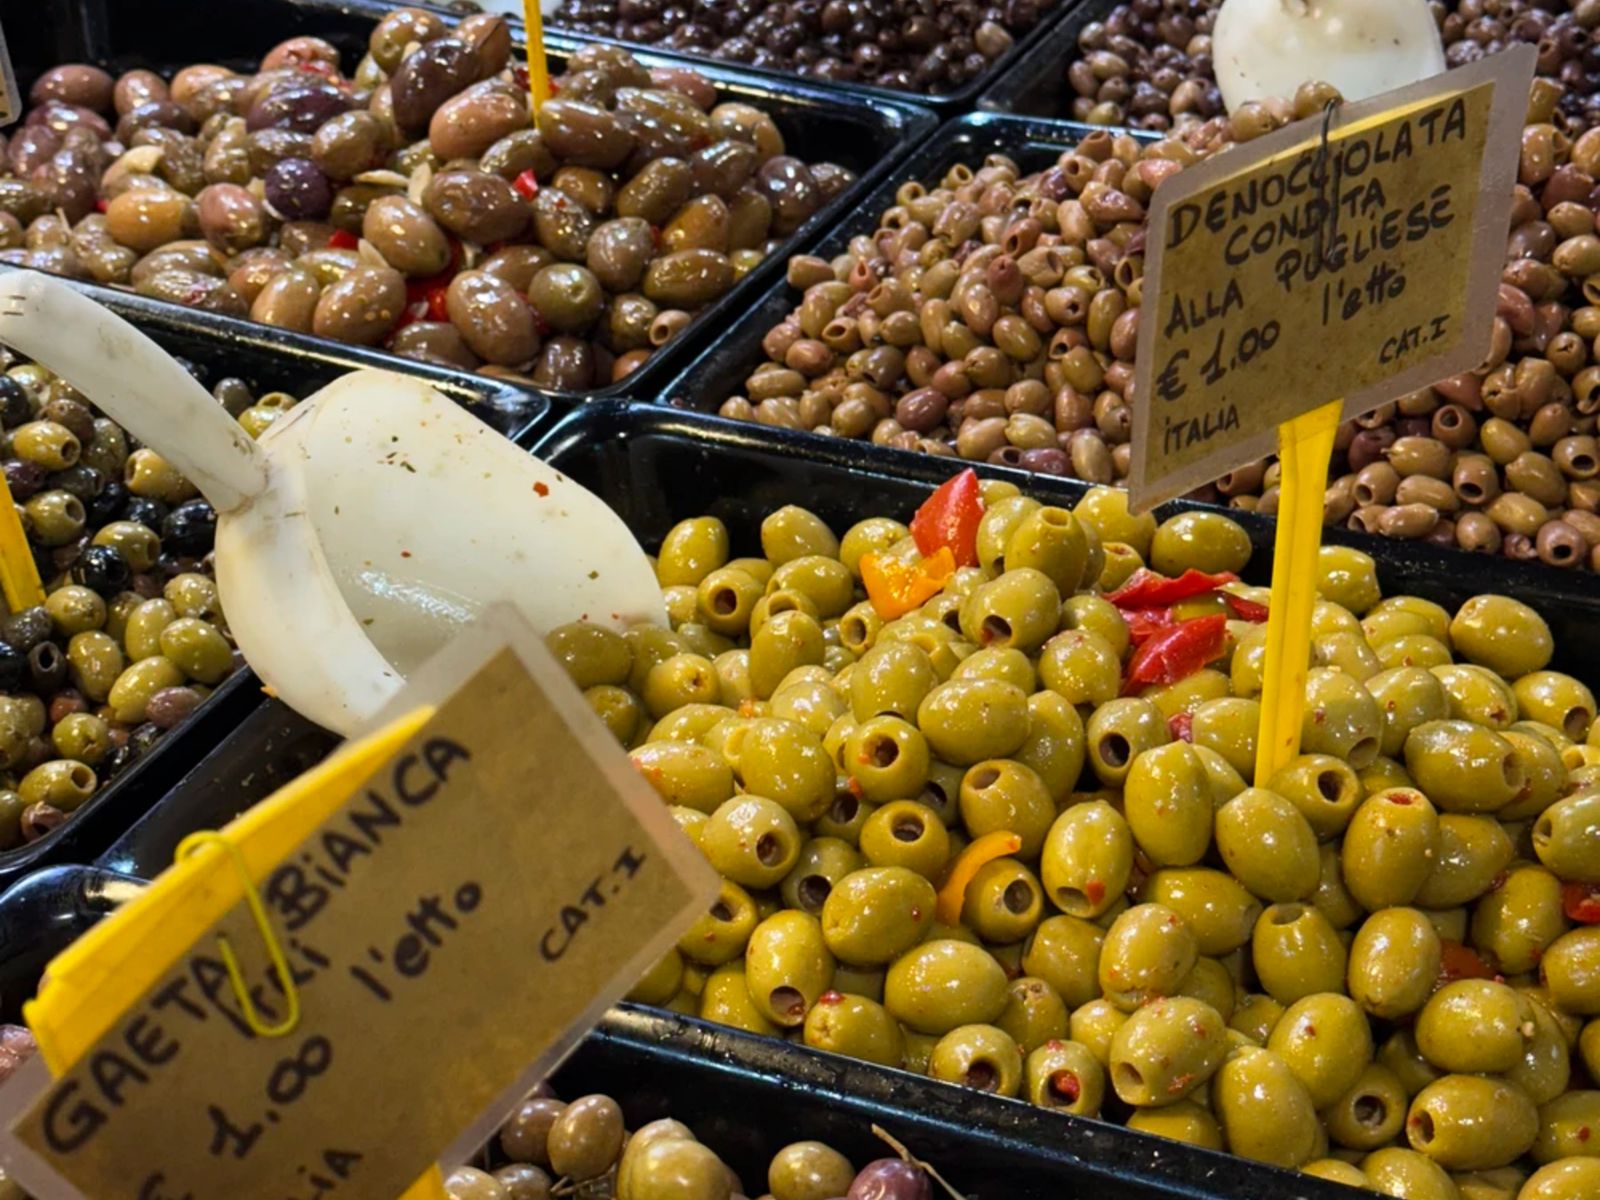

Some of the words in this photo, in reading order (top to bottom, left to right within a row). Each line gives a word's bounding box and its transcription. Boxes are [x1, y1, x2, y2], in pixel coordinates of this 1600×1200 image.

[1224, 177, 1386, 265] CONDTA
[1156, 349, 1190, 401] €
[1200, 319, 1281, 386] 1.00
[1322, 262, 1407, 326] l'etto
[1164, 278, 1244, 339] ALLA
[43, 956, 238, 1154] GAETA
[207, 1034, 333, 1160] 1.00
[350, 881, 483, 1001] l'etto
